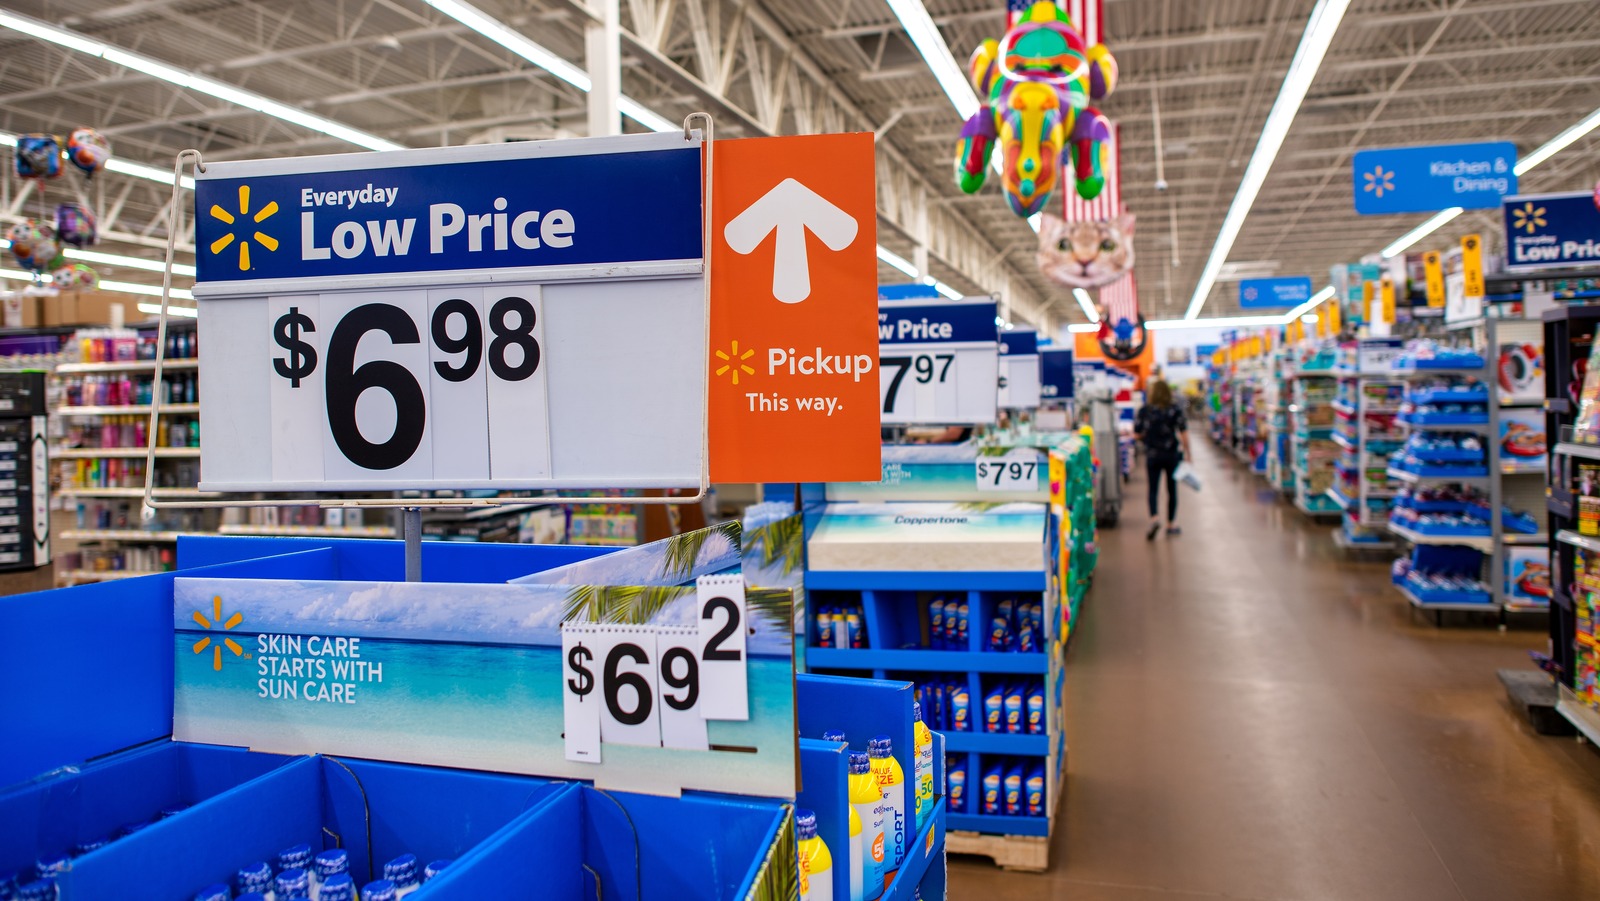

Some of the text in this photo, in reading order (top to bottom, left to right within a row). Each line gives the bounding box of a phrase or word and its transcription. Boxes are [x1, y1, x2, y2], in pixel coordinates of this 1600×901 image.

[1430, 156, 1508, 176] Kitchen &
[301, 183, 399, 209] Everyday
[1453, 176, 1508, 194] Dining
[301, 197, 576, 261] Low Price
[1515, 239, 1600, 261] Low Pric
[898, 317, 953, 339] Price
[768, 346, 873, 382] Pickup
[745, 392, 843, 416] This way.
[894, 515, 968, 525] Coppertone
[257, 633, 361, 658] SKIN CARE
[257, 656, 383, 683] STARTS WITH
[257, 678, 356, 704] SUN CARE
[921, 780, 933, 796] 50
[894, 810, 904, 867] SPORT
